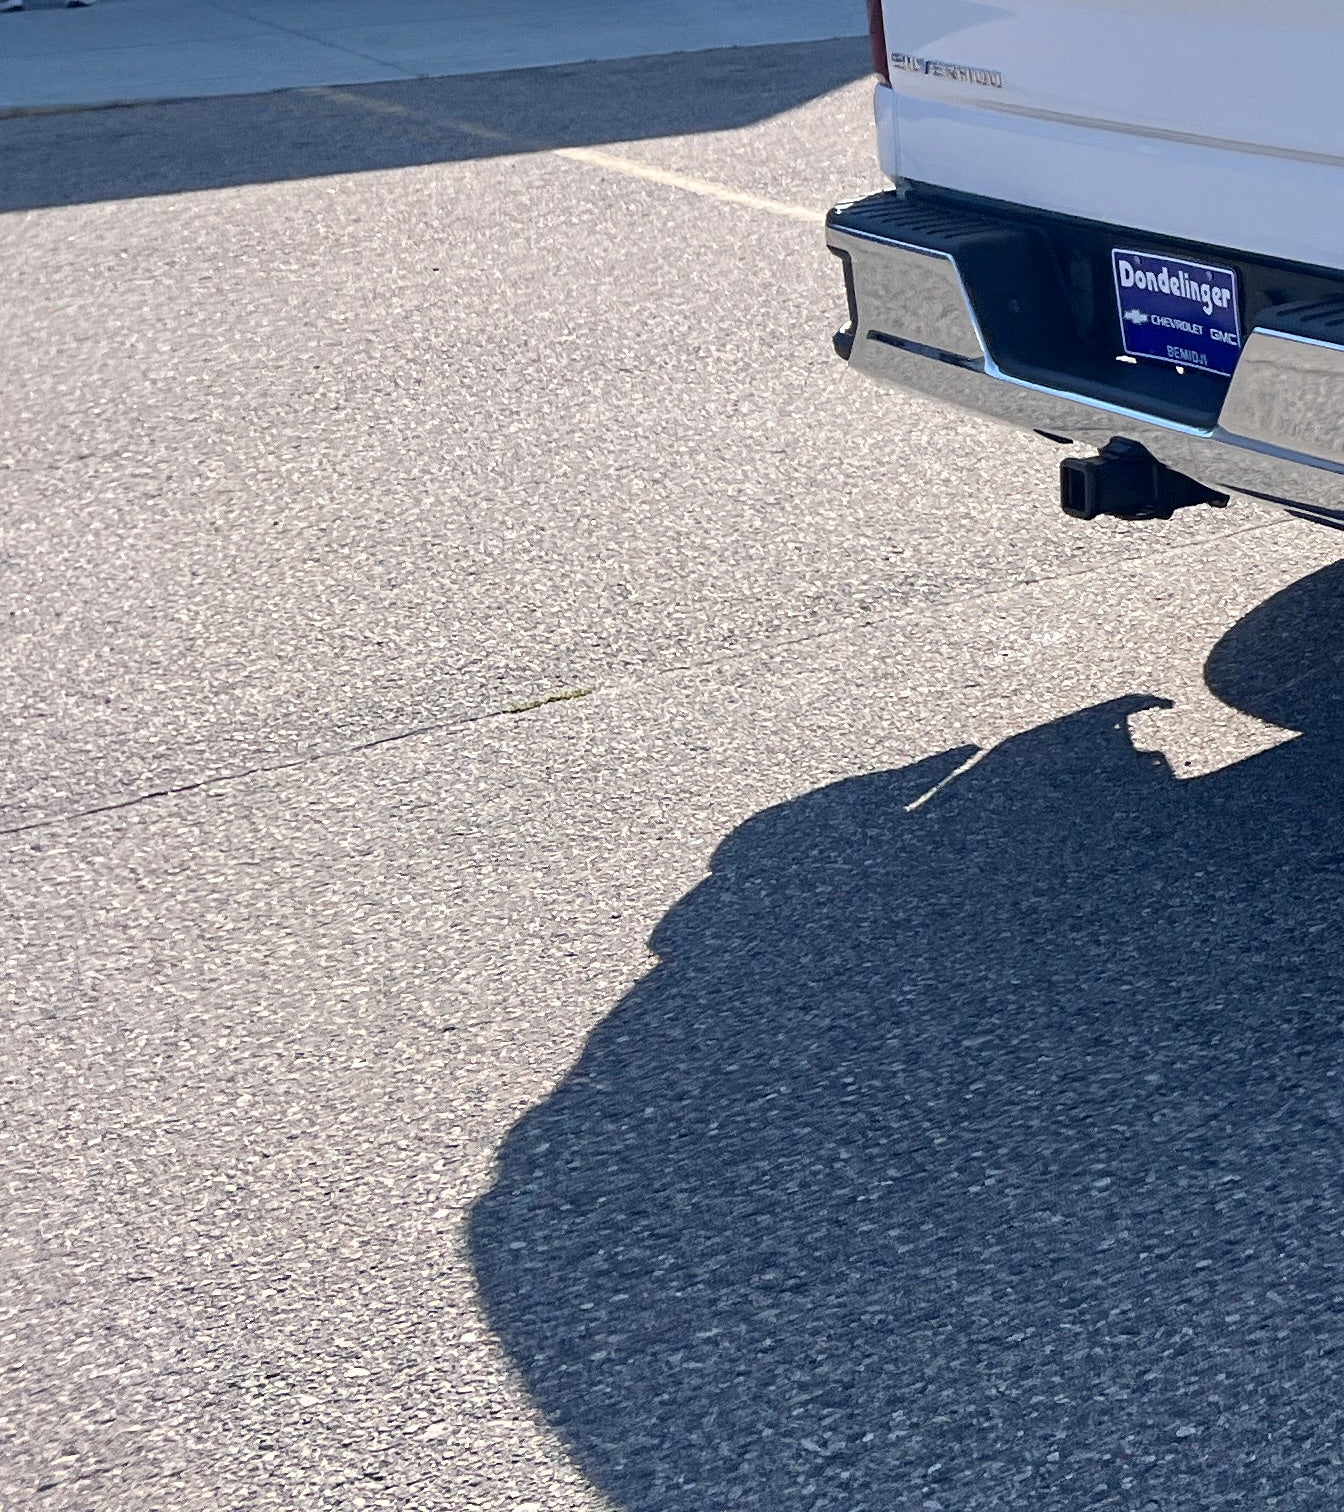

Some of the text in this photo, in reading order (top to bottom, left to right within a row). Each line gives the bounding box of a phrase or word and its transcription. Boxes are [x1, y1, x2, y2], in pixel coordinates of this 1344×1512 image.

[1118, 259, 1231, 316] Dondelinger
[1150, 314, 1238, 346] CHEVROLET GMC
[1166, 344, 1208, 366] BEMIDJI
